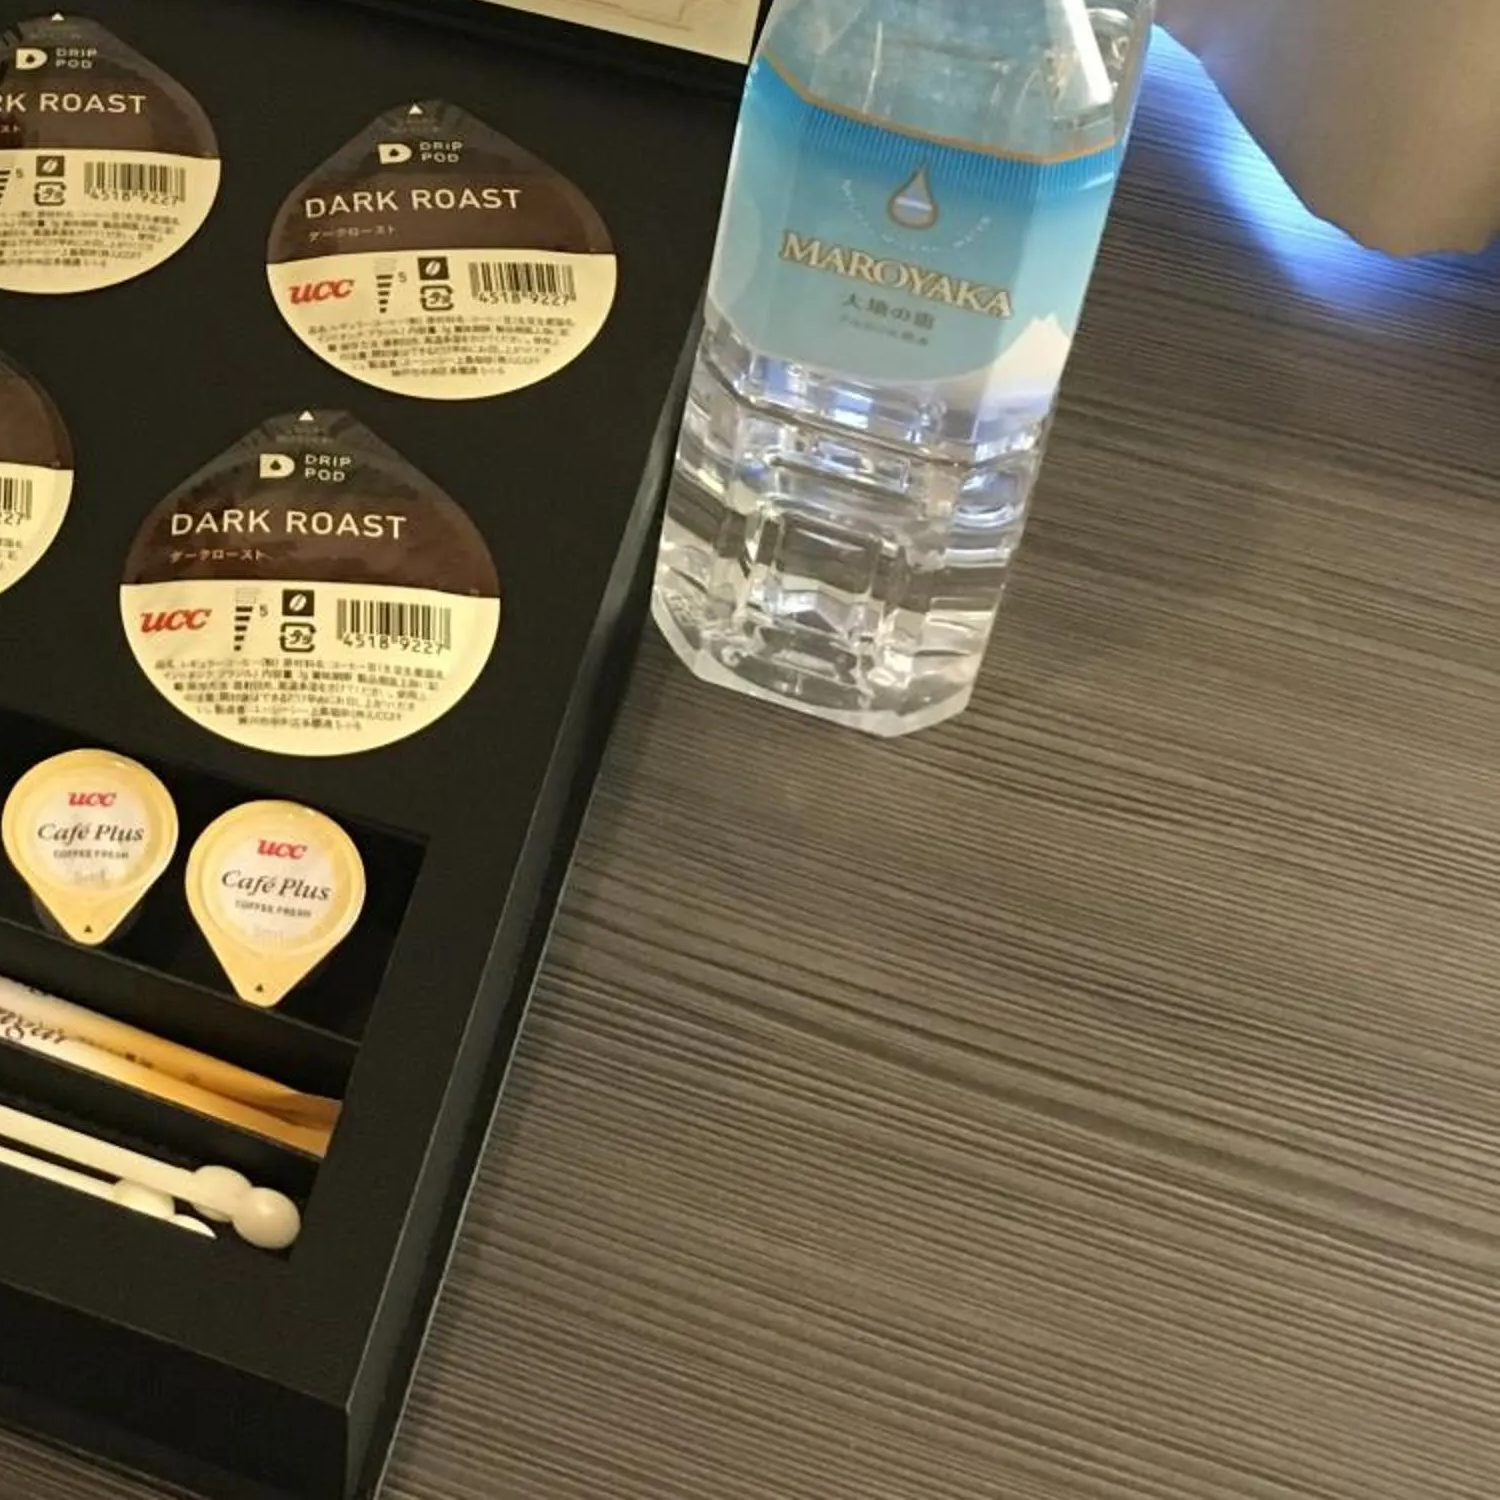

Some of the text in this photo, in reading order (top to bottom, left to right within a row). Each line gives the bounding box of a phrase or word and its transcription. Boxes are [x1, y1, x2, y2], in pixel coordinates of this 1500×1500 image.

[55, 48, 98, 58] DRIP
[55, 59, 94, 69] POD
[39, 92, 148, 115] ROAST
[419, 140, 464, 152] DRIP
[420, 152, 460, 163] POD
[304, 187, 523, 219] DARK ROAST
[780, 230, 1014, 320] MAROYAKA
[304, 454, 352, 468] DRIP
[304, 467, 346, 482] POD
[170, 509, 407, 540] DARK ROAST
[342, 632, 446, 657] 4518 9227
[36, 822, 146, 848] Café Plus
[221, 868, 333, 902] Café Plus
